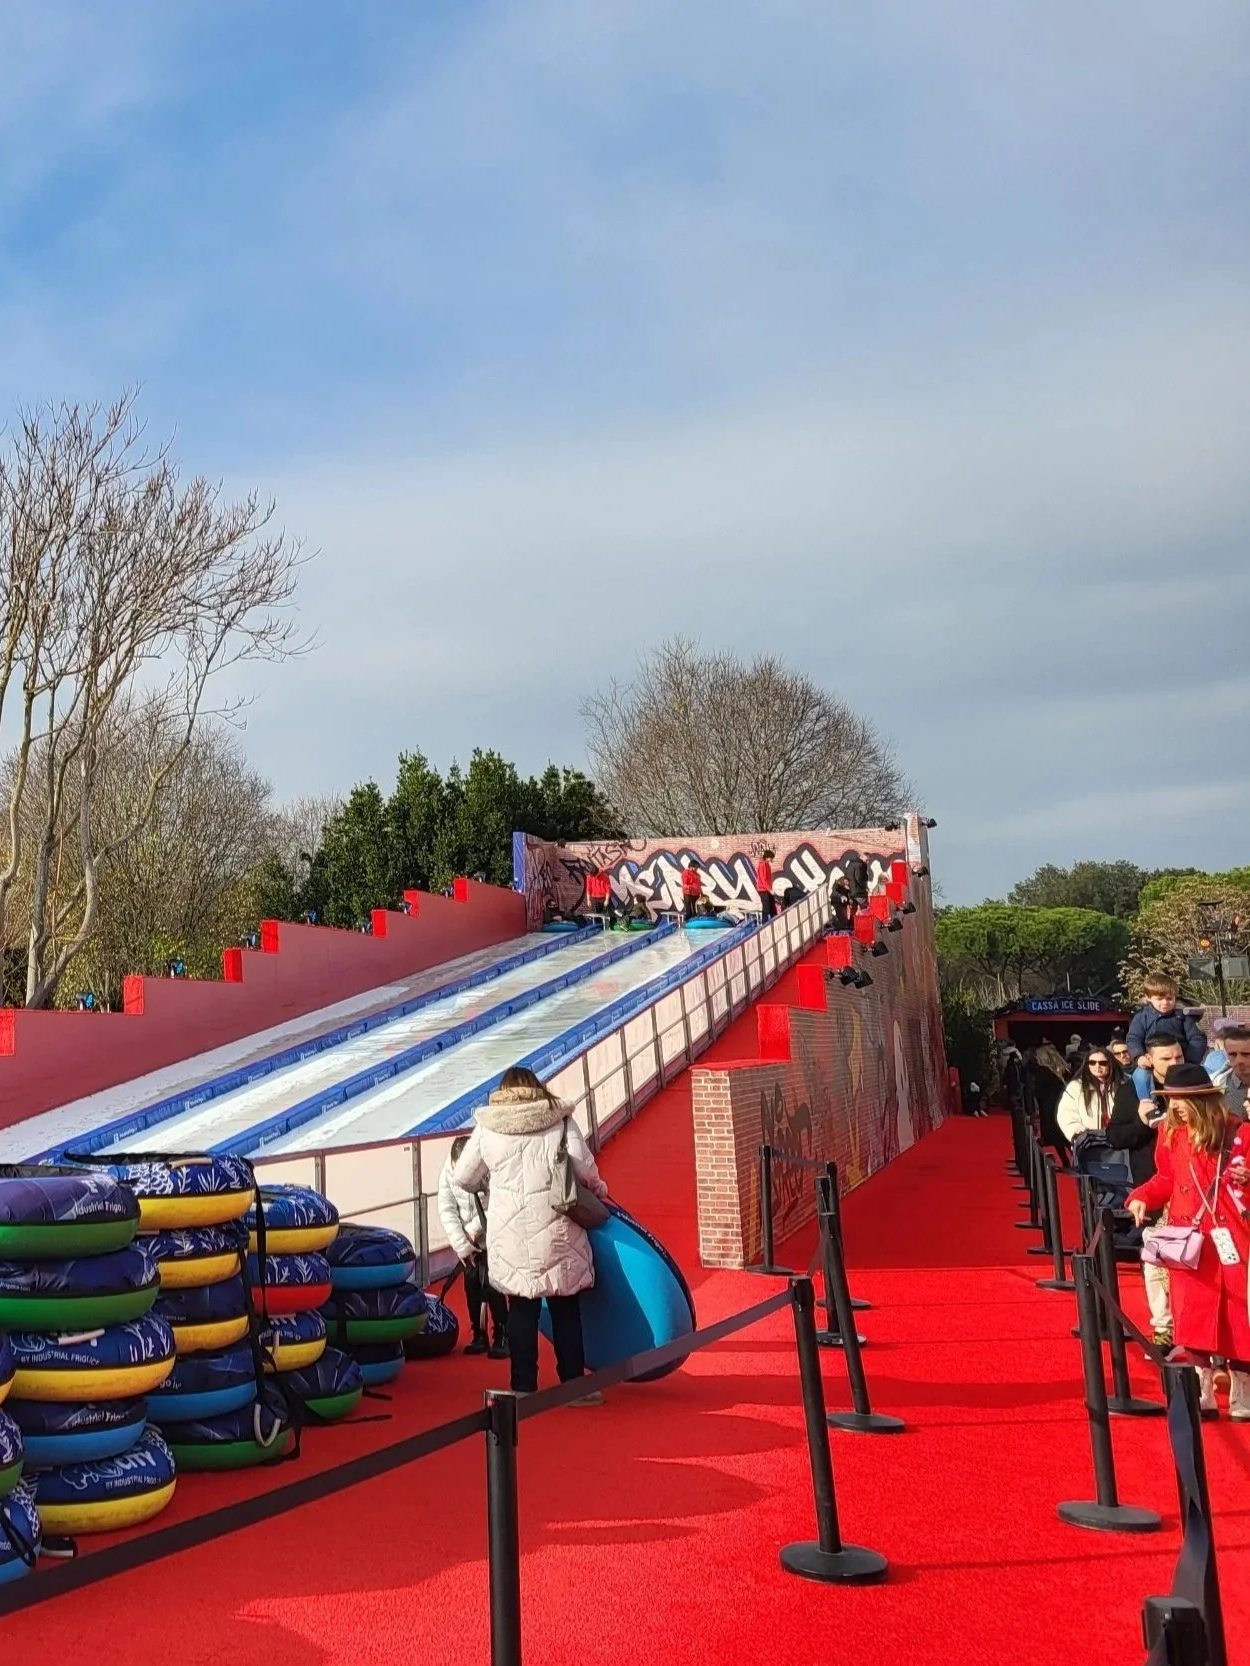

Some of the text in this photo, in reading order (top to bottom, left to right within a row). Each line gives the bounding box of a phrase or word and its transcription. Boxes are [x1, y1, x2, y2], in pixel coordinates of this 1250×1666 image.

[1031, 1000, 1100, 1012] CASSA ICE SLIDE
